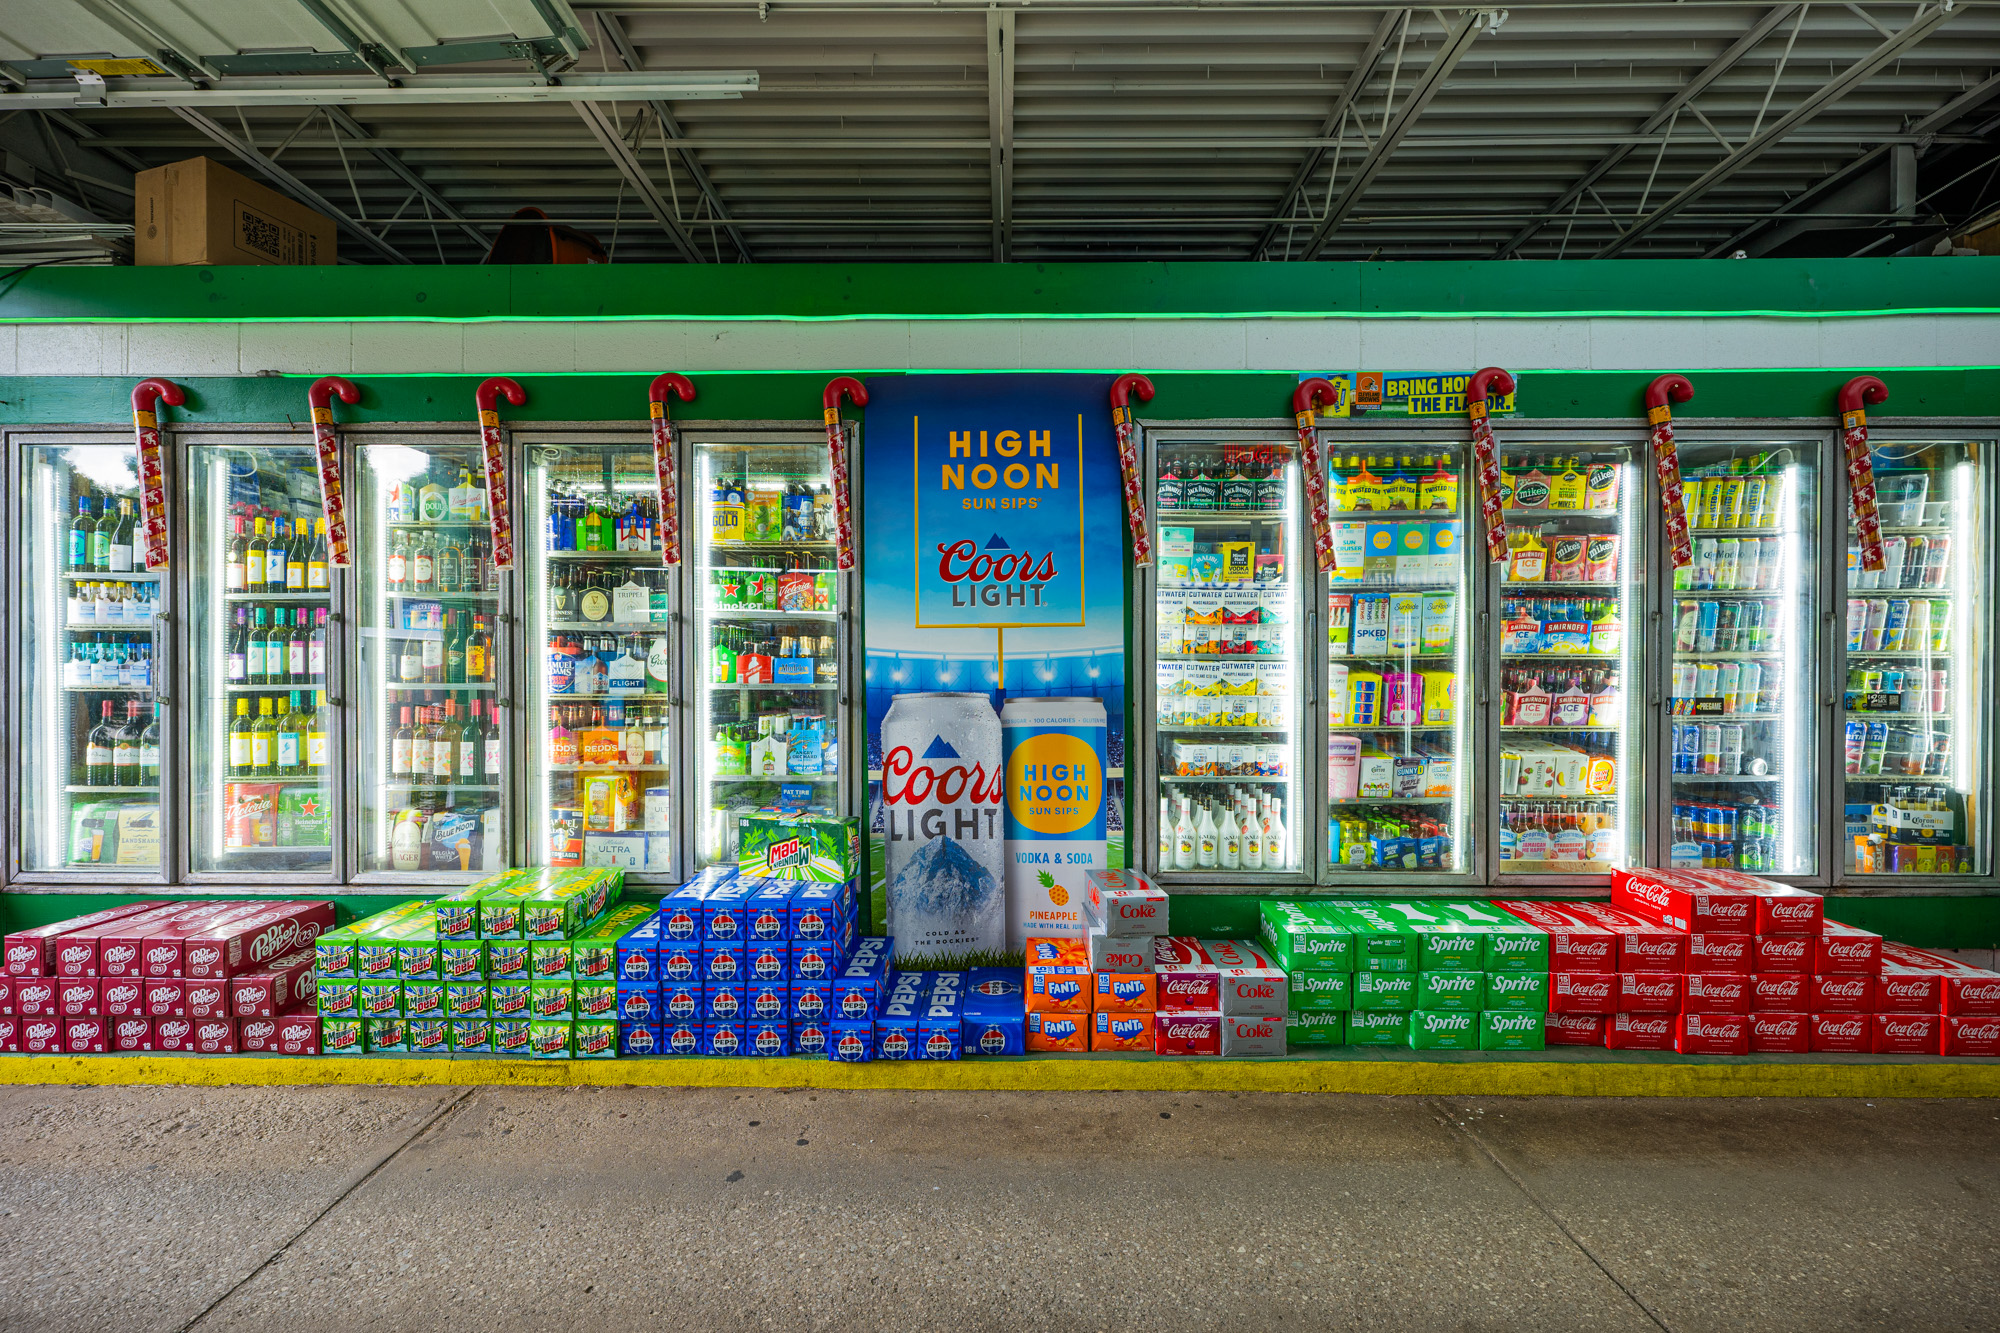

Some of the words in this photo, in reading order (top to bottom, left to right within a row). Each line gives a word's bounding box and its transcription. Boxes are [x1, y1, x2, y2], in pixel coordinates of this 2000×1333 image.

[1387, 378, 1438, 397] BRING
[1442, 376, 1472, 393] HO
[1411, 396, 1441, 412] THE
[1446, 395, 1511, 411] FLAOR.
[949, 430, 1051, 458] HIGH
[941, 463, 1059, 490] NOON
[1590, 469, 1615, 487] mike's
[1520, 487, 1547, 498] mike's
[962, 498, 996, 510] SUN
[713, 516, 738, 526] GOLD
[1556, 542, 1580, 557] mike's
[1589, 542, 1613, 558] mike's
[937, 539, 1058, 583] Coors
[1196, 555, 1219, 564] MALIBU
[779, 580, 812, 596] Victoria
[952, 584, 1046, 607] LIGHT
[882, 745, 1003, 807] Coors
[1024, 764, 1086, 781] HIGH
[1019, 785, 1089, 801] NOON
[227, 800, 272, 820] Victoria
[1029, 807, 1051, 815] SUN
[1054, 807, 1079, 815] SIPS
[436, 830, 455, 841] BLUE
[455, 822, 474, 834] MOON
[890, 808, 998, 841] LIGHT
[1015, 852, 1050, 864] VODKA
[1054, 852, 1062, 864] &
[1066, 852, 1093, 864] SODA
[1100, 871, 1126, 888] Coke
[1626, 877, 1672, 907] Coca-Cola
[1634, 898, 1650, 907] ORIGINAL
[1710, 903, 1748, 917] Coca-Cola
[1029, 910, 1078, 921] PINEAPPLE
[1120, 904, 1156, 918] Coke
[1772, 903, 1814, 918] Coca-Cola
[267, 924, 284, 943] Dr
[256, 925, 295, 962] Pepper
[1308, 940, 1346, 954] Sprite
[1428, 936, 1474, 953] Sprite
[1494, 936, 1540, 954] Sprite
[1569, 942, 1609, 956] Coca-Cola
[1638, 942, 1678, 956] Coca-Cola
[1704, 942, 1744, 956] Coca-Cola
[1762, 941, 1804, 956] Coca-Cola
[1828, 942, 1874, 958] Coca-Cola
[8, 950, 35, 962] Pepper
[62, 950, 90, 962] Pepper
[106, 950, 133, 963] Pepper
[844, 938, 886, 977] PEPSI
[1106, 953, 1142, 968] Coke
[1048, 981, 1080, 994] FANTA
[1113, 980, 1146, 994] FANTA
[1167, 980, 1209, 994] Coca-Cola
[1237, 984, 1274, 998] Coke
[1305, 978, 1344, 992] Sprite
[1373, 978, 1411, 993] Sprite
[1428, 976, 1475, 993] Sprite
[1492, 976, 1539, 993] Sprite
[1570, 982, 1610, 996] Coca-Cola
[1636, 983, 1675, 996] Coca-Cola
[1702, 984, 1742, 998] Coca-Cola
[886, 972, 923, 1016] PEPSI
[928, 972, 960, 1017] PEPSI
[1044, 1020, 1076, 1034] FANTA
[1112, 1020, 1144, 1032] FANTA
[1300, 1013, 1336, 1028] Sprite
[1366, 1014, 1402, 1028] Sprite
[1424, 1015, 1470, 1032] Sprite
[1558, 1016, 1598, 1030] Coca-Cola
[1629, 1020, 1668, 1033] Coca-Cola
[1168, 1024, 1210, 1039] Coca-Cola
[1236, 1024, 1272, 1038] Coke
